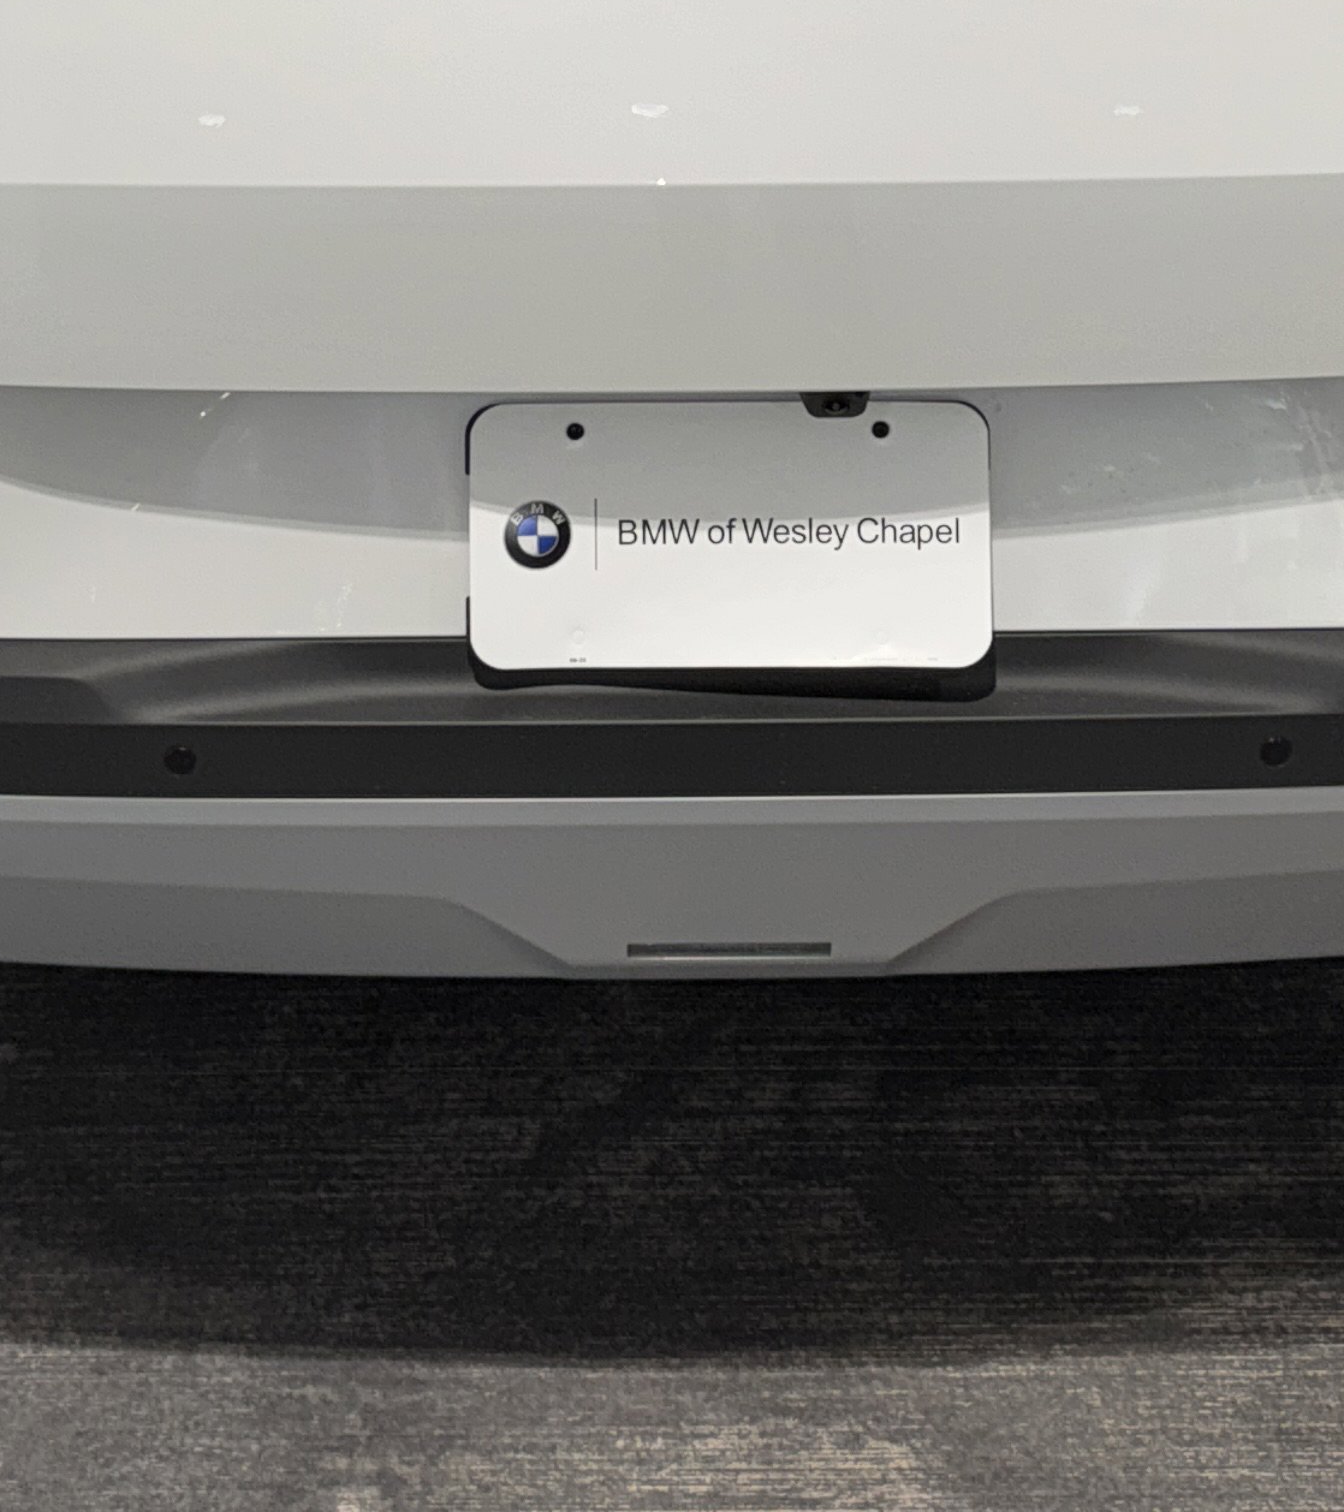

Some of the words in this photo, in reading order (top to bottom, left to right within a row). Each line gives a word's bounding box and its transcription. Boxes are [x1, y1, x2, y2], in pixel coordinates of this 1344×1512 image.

[510, 503, 566, 526] BMW
[618, 518, 700, 545] BMW
[707, 517, 737, 545] of
[742, 517, 849, 551] Wesley
[857, 517, 959, 550] Chapel
